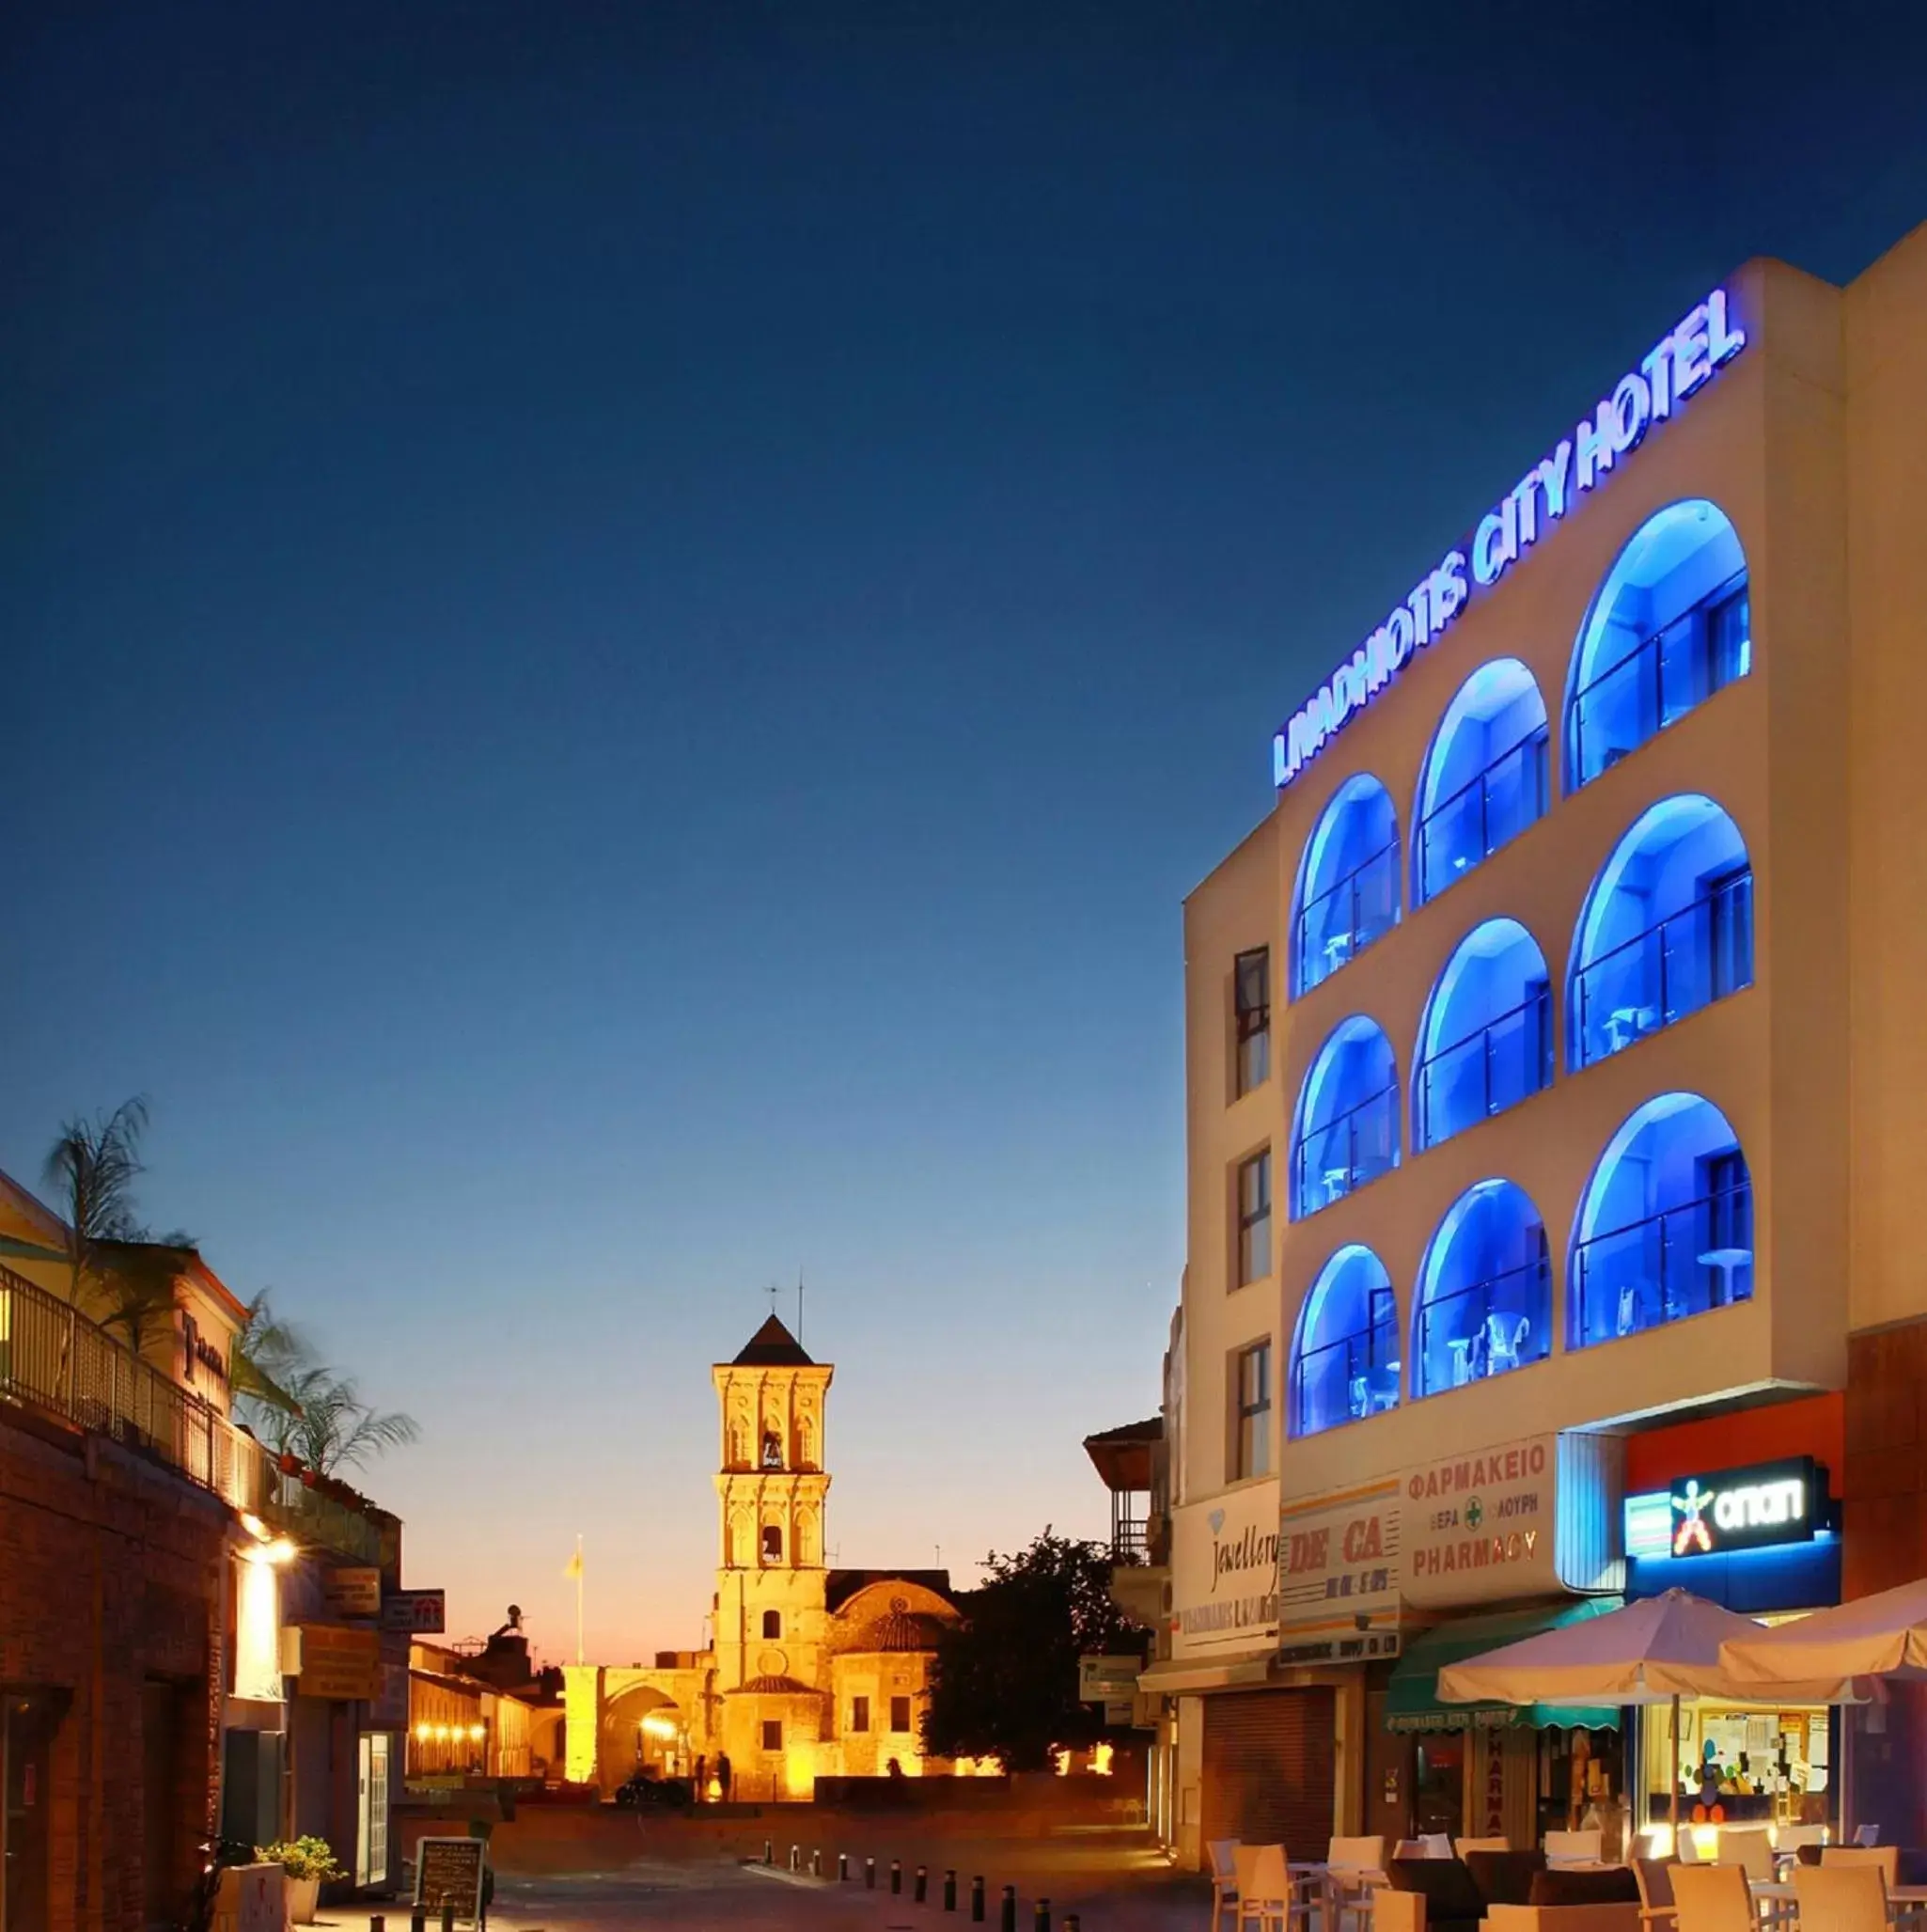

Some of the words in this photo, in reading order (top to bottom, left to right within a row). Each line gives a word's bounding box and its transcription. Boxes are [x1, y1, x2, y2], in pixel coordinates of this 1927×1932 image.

[1273, 549, 1470, 788] LIVADHIOTIS
[1472, 438, 1573, 587] CITY
[1576, 288, 1747, 493] HOTEL
[1409, 1443, 1545, 1501] ΦΑΡΜΑΚΕΙΟ
[1413, 1530, 1537, 1577] PHARMACY
